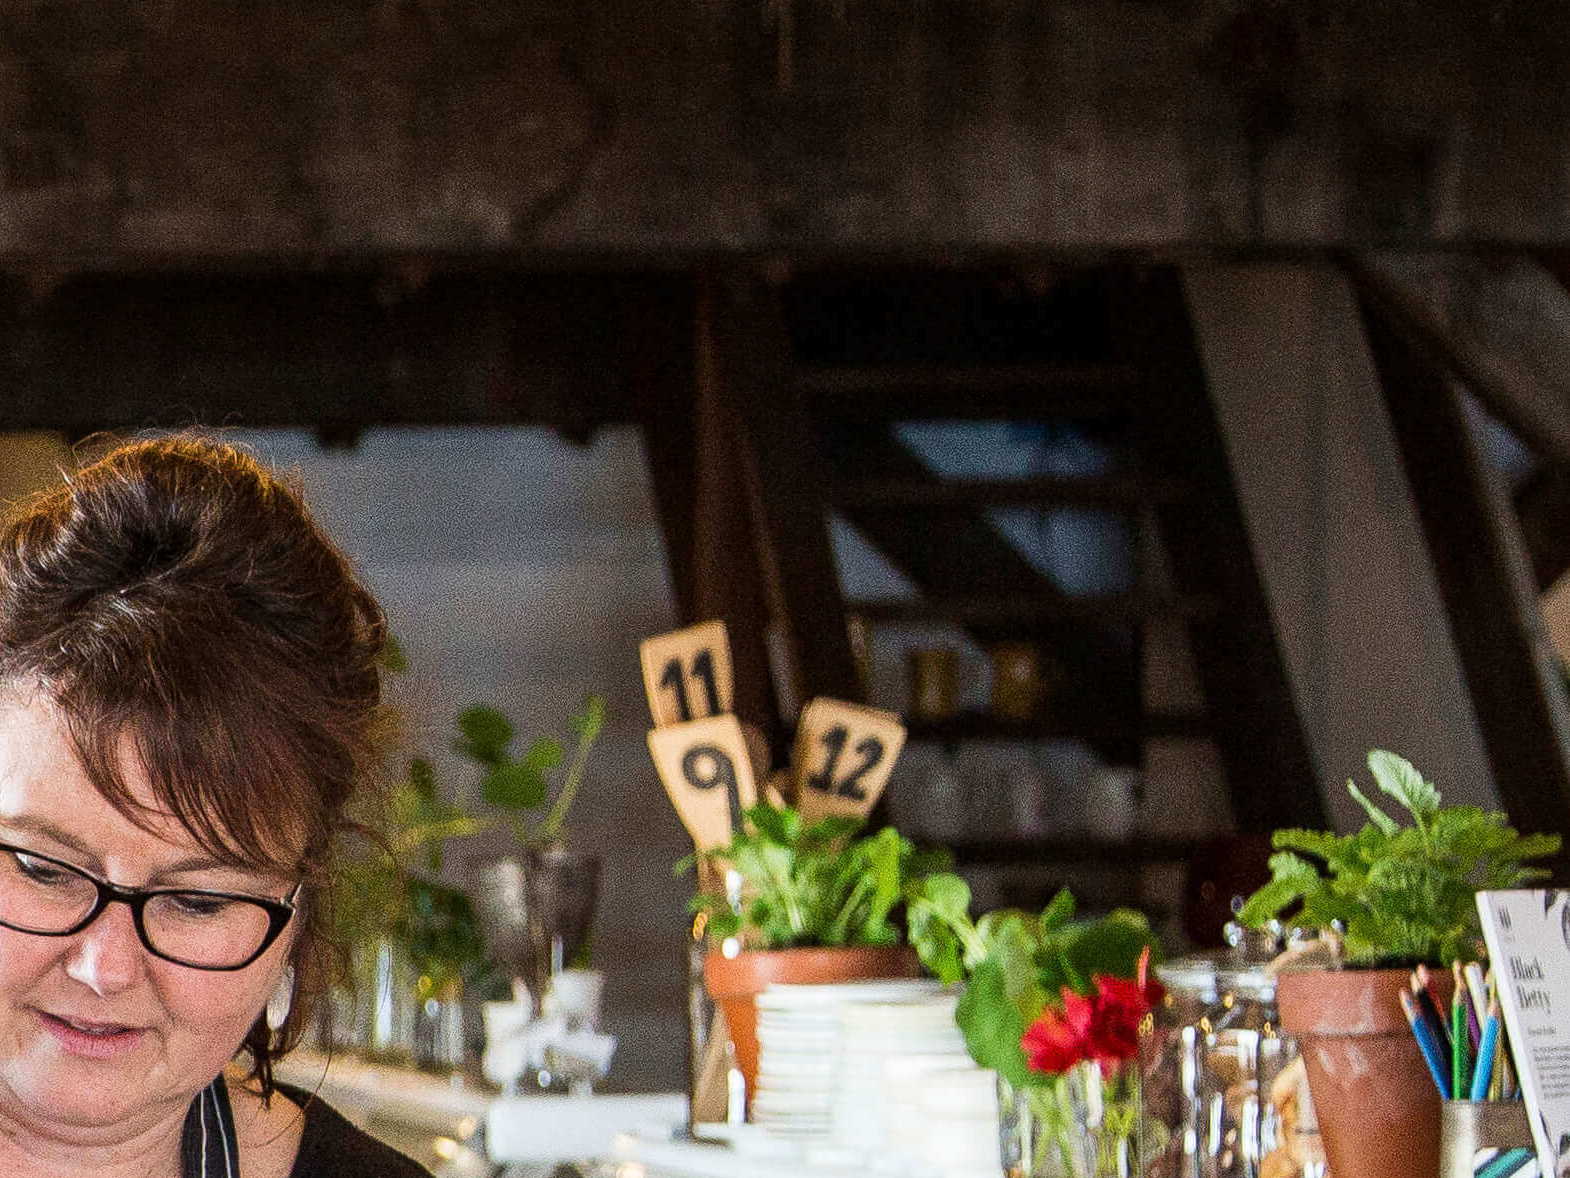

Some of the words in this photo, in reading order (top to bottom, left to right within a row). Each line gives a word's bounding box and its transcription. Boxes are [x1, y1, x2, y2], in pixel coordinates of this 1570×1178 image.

[660, 648, 721, 722] 11
[681, 745, 744, 837] 9
[810, 724, 885, 801] 12
